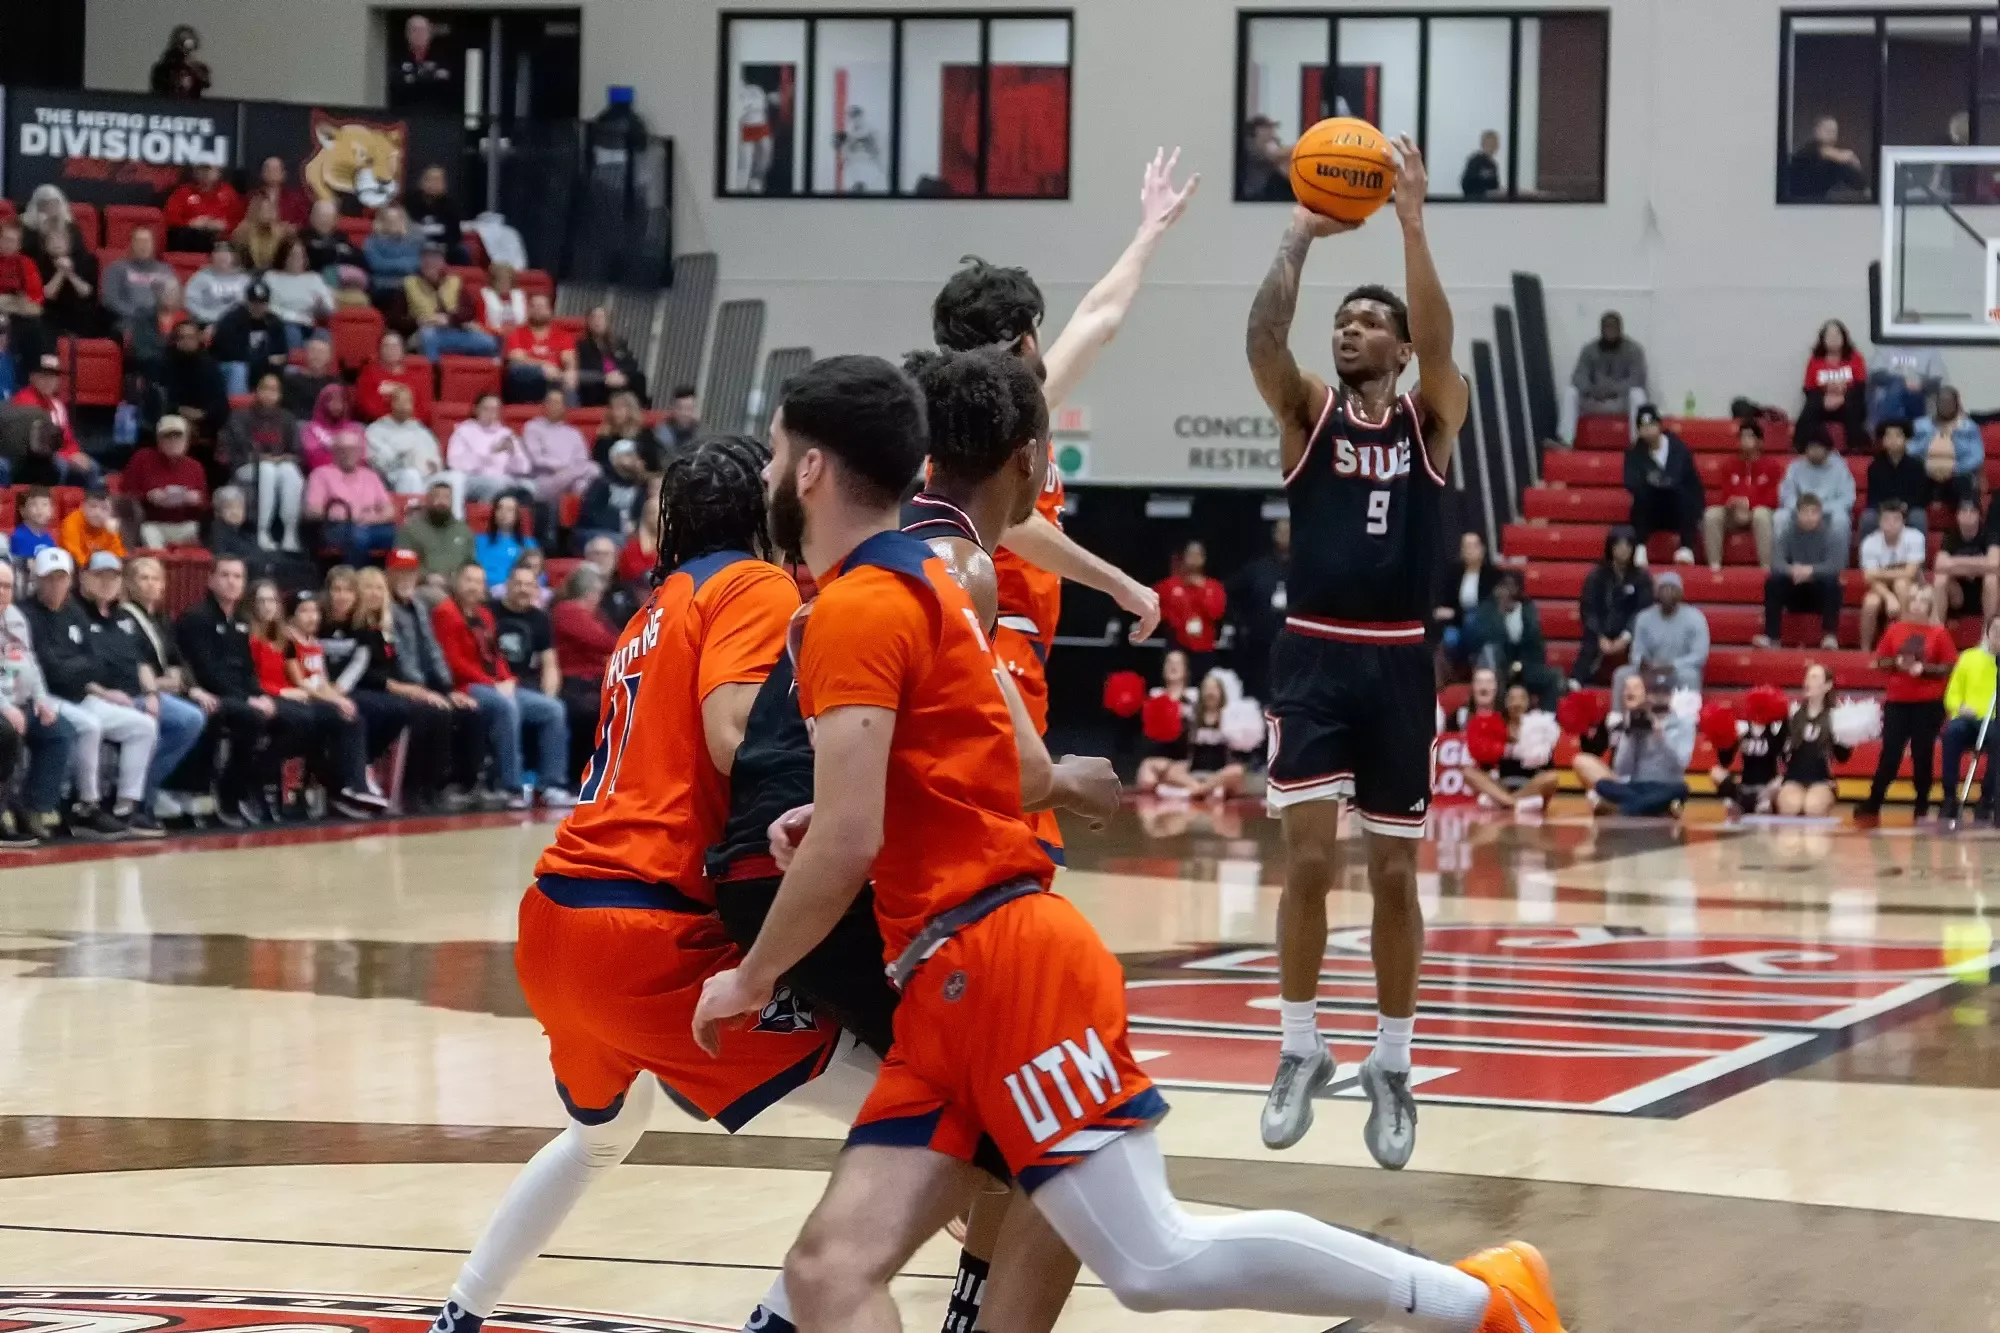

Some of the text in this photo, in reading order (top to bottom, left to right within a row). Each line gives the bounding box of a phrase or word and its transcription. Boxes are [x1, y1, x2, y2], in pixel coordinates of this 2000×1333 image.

[35, 107, 73, 125] THE
[76, 110, 146, 130] METRO
[1315, 162, 1384, 189] Wilson
[1333, 437, 1411, 480] SIUE
[1365, 490, 1391, 535] 9
[1002, 1026, 1122, 1144] UTM
